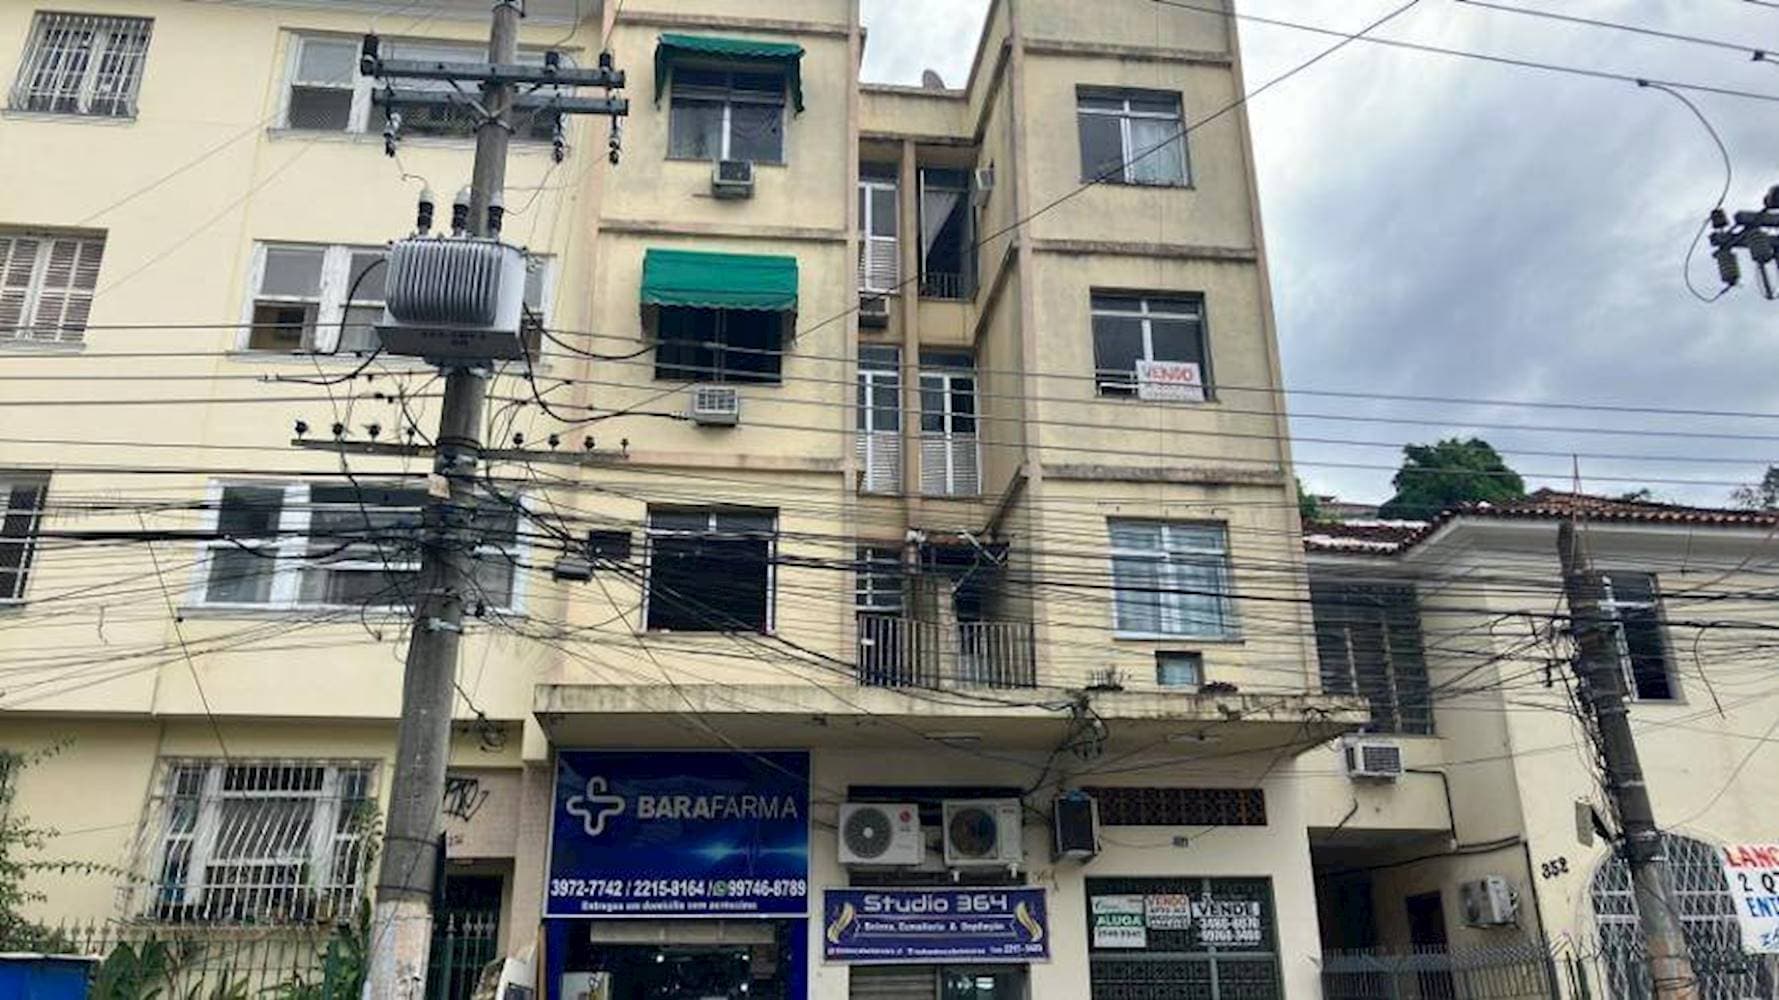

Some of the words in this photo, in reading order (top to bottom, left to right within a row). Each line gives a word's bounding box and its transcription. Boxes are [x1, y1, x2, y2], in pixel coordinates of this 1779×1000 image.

[636, 795, 799, 820] BARAFARMA
[1541, 856, 1570, 880] 352
[550, 878, 623, 897] 3972-7742
[633, 879, 705, 897] 2215-8164
[727, 878, 806, 897] 99746-8789
[1738, 872, 1754, 892] 2
[863, 893, 949, 912] Studio
[956, 893, 1008, 912] 364
[1097, 914, 1142, 926] ALUGA
